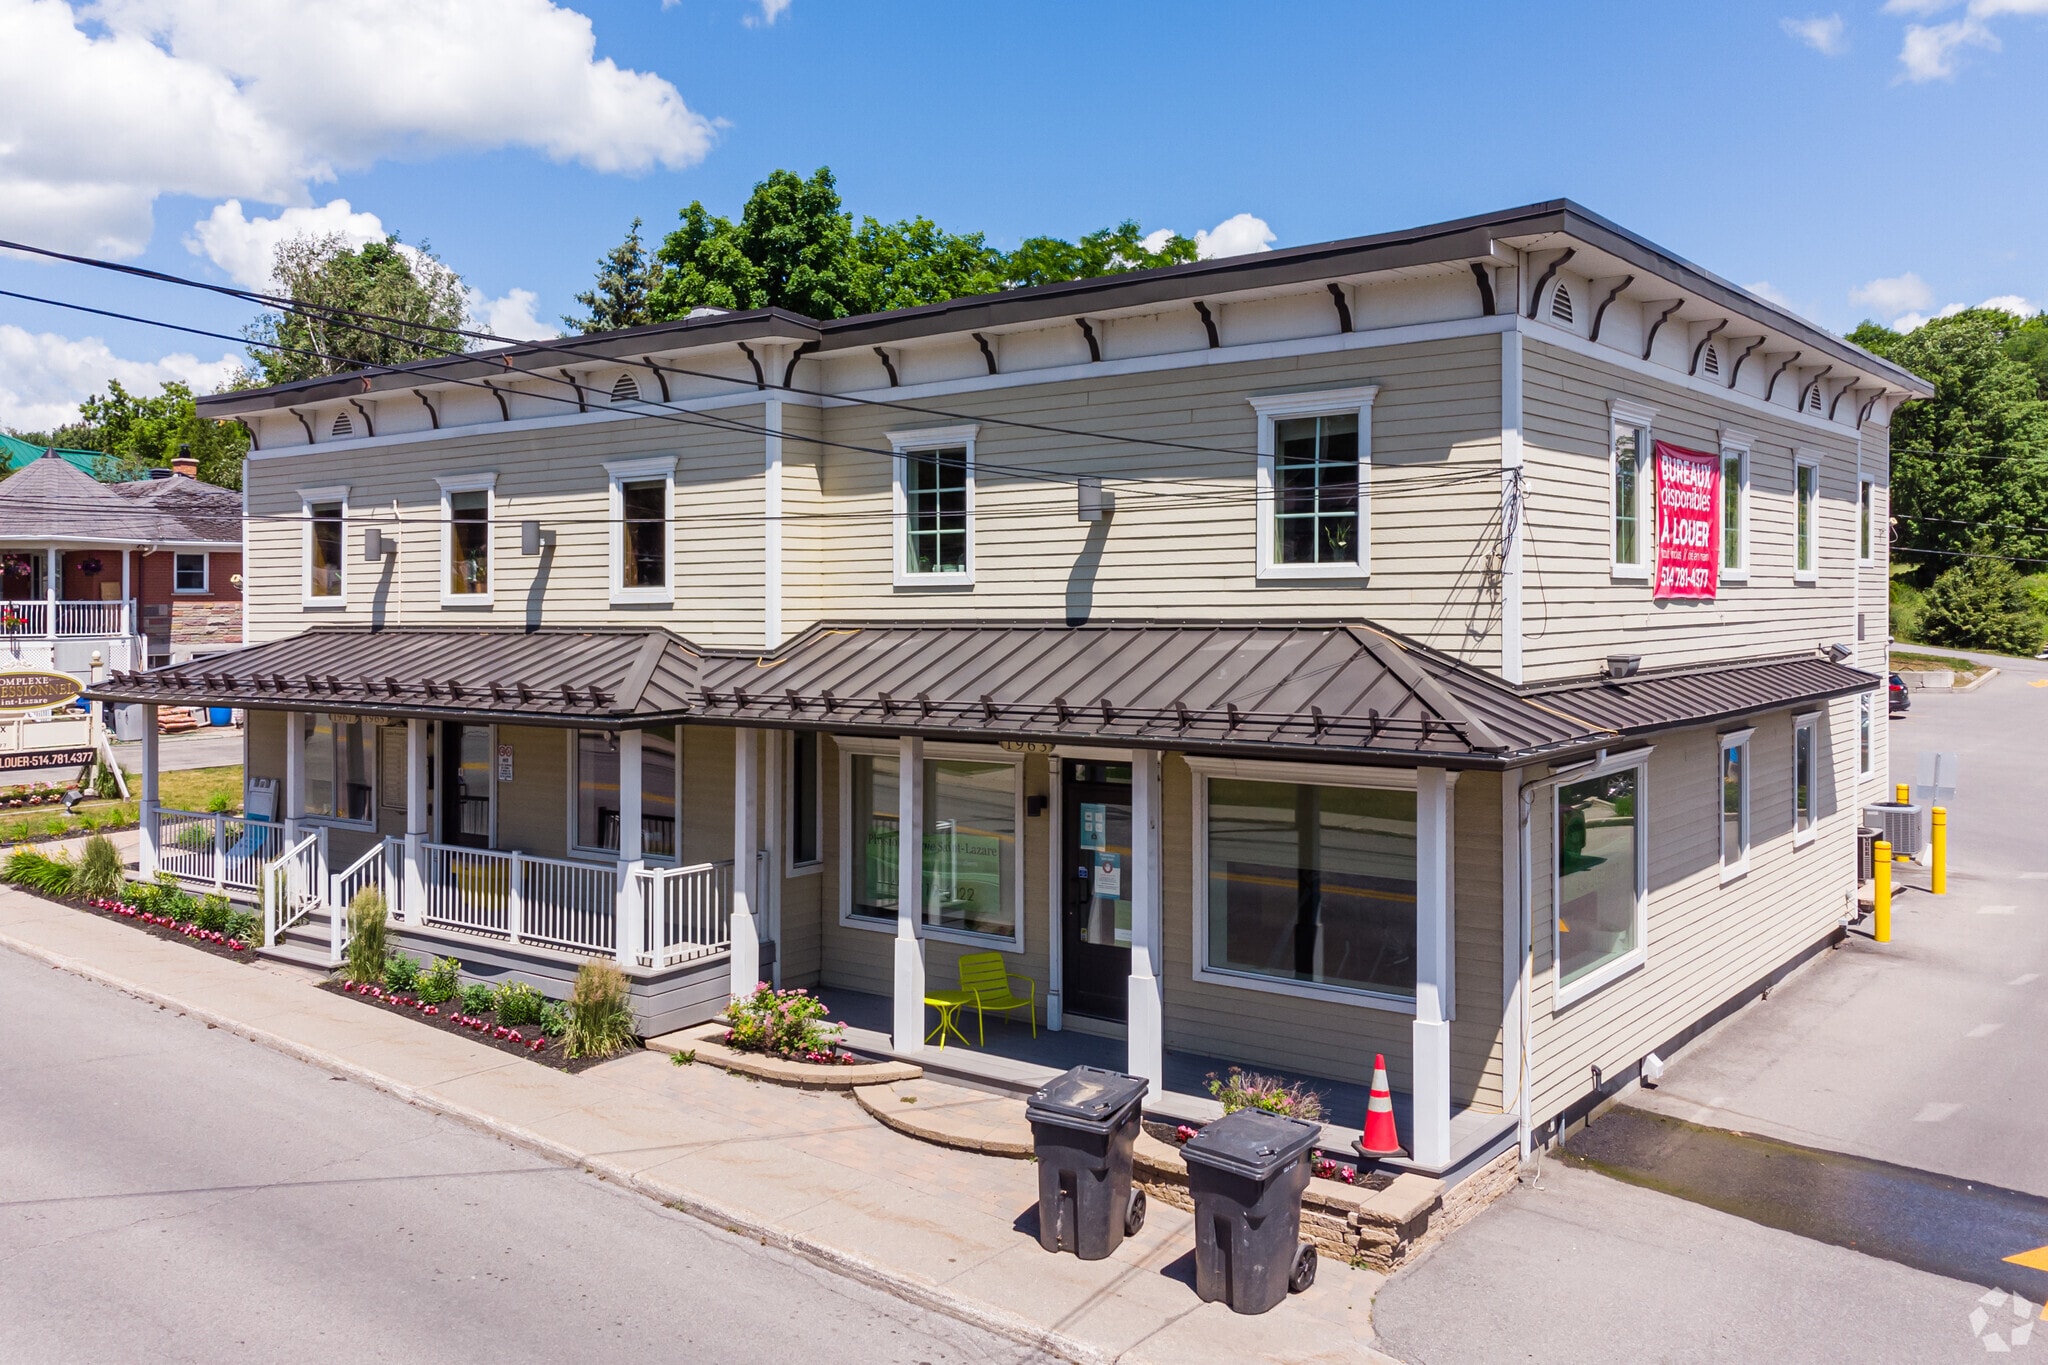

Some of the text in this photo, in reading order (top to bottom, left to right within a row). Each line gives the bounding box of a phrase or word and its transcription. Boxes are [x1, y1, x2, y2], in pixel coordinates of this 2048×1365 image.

[1662, 455, 1711, 489] BUREAUX
[1661, 482, 1711, 511] disponibles
[1661, 508, 1709, 547] À LOUER
[1661, 566, 1709, 588] 514 781-4377
